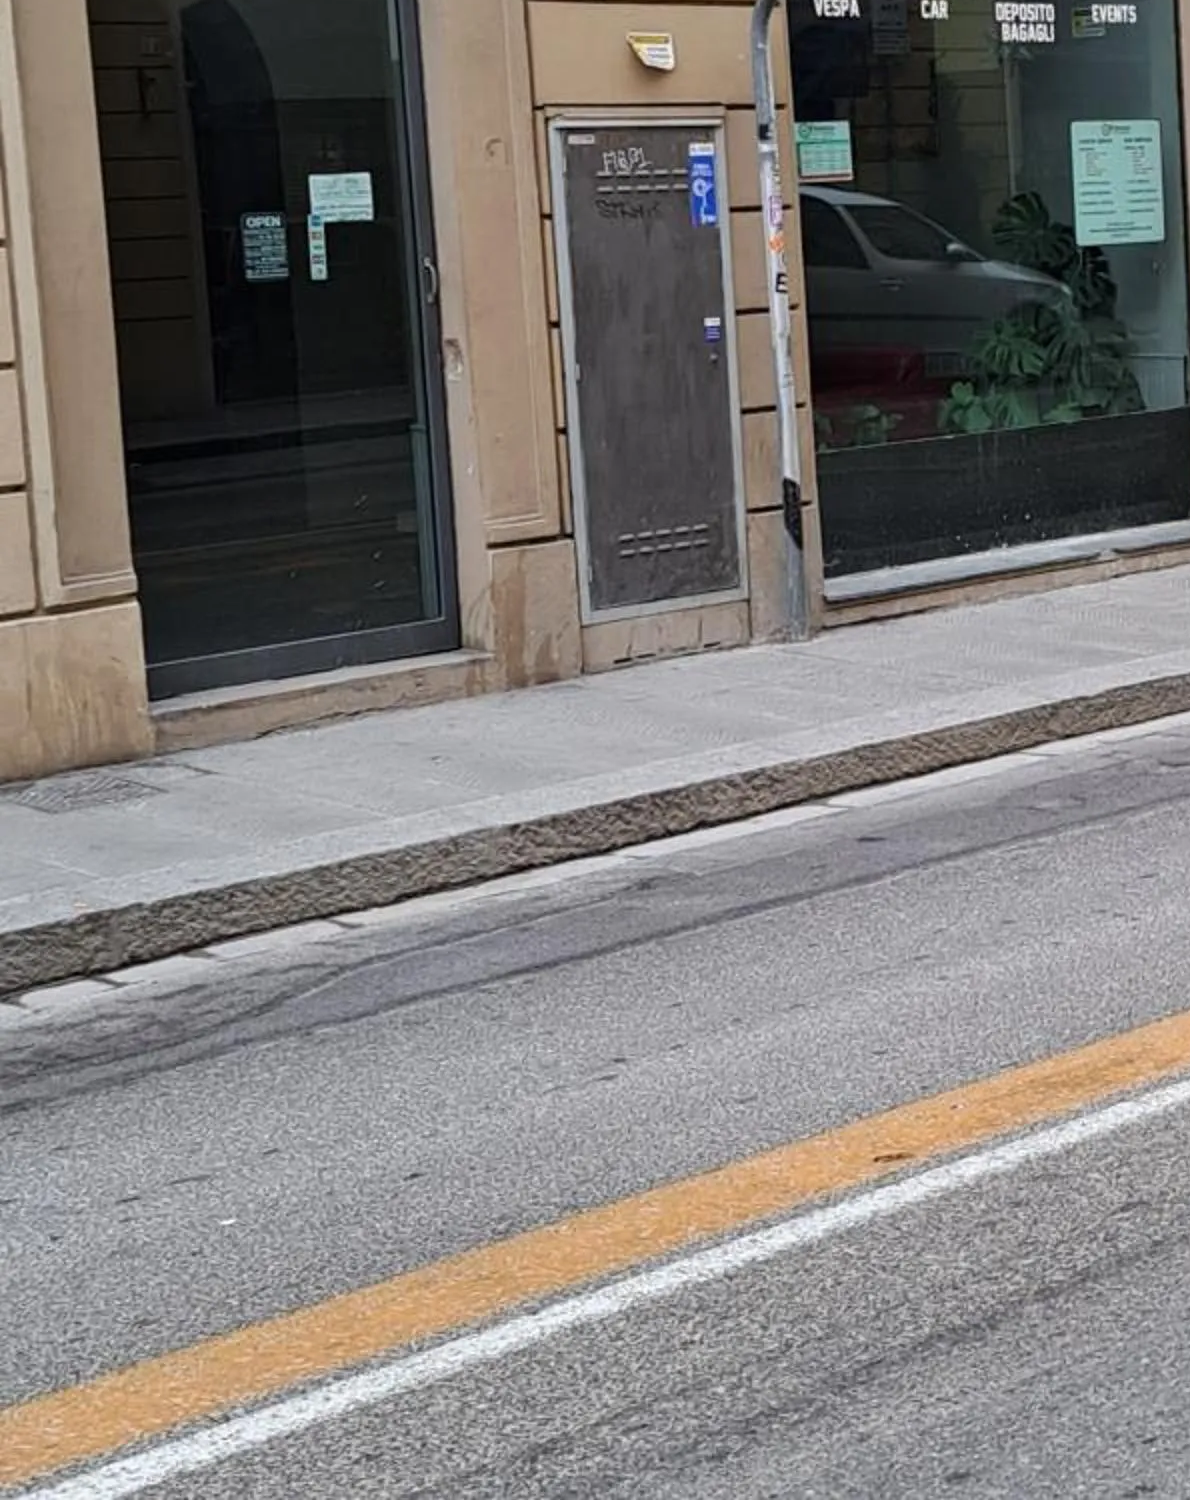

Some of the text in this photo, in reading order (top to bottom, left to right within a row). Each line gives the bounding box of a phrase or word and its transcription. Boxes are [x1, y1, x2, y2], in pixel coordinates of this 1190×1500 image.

[920, 0, 949, 20] CAR
[995, 3, 1056, 22] DEPOSITO
[1091, 4, 1138, 24] EVENTS
[1001, 22, 1056, 43] BAGAGLI
[245, 215, 281, 228] OPEN
